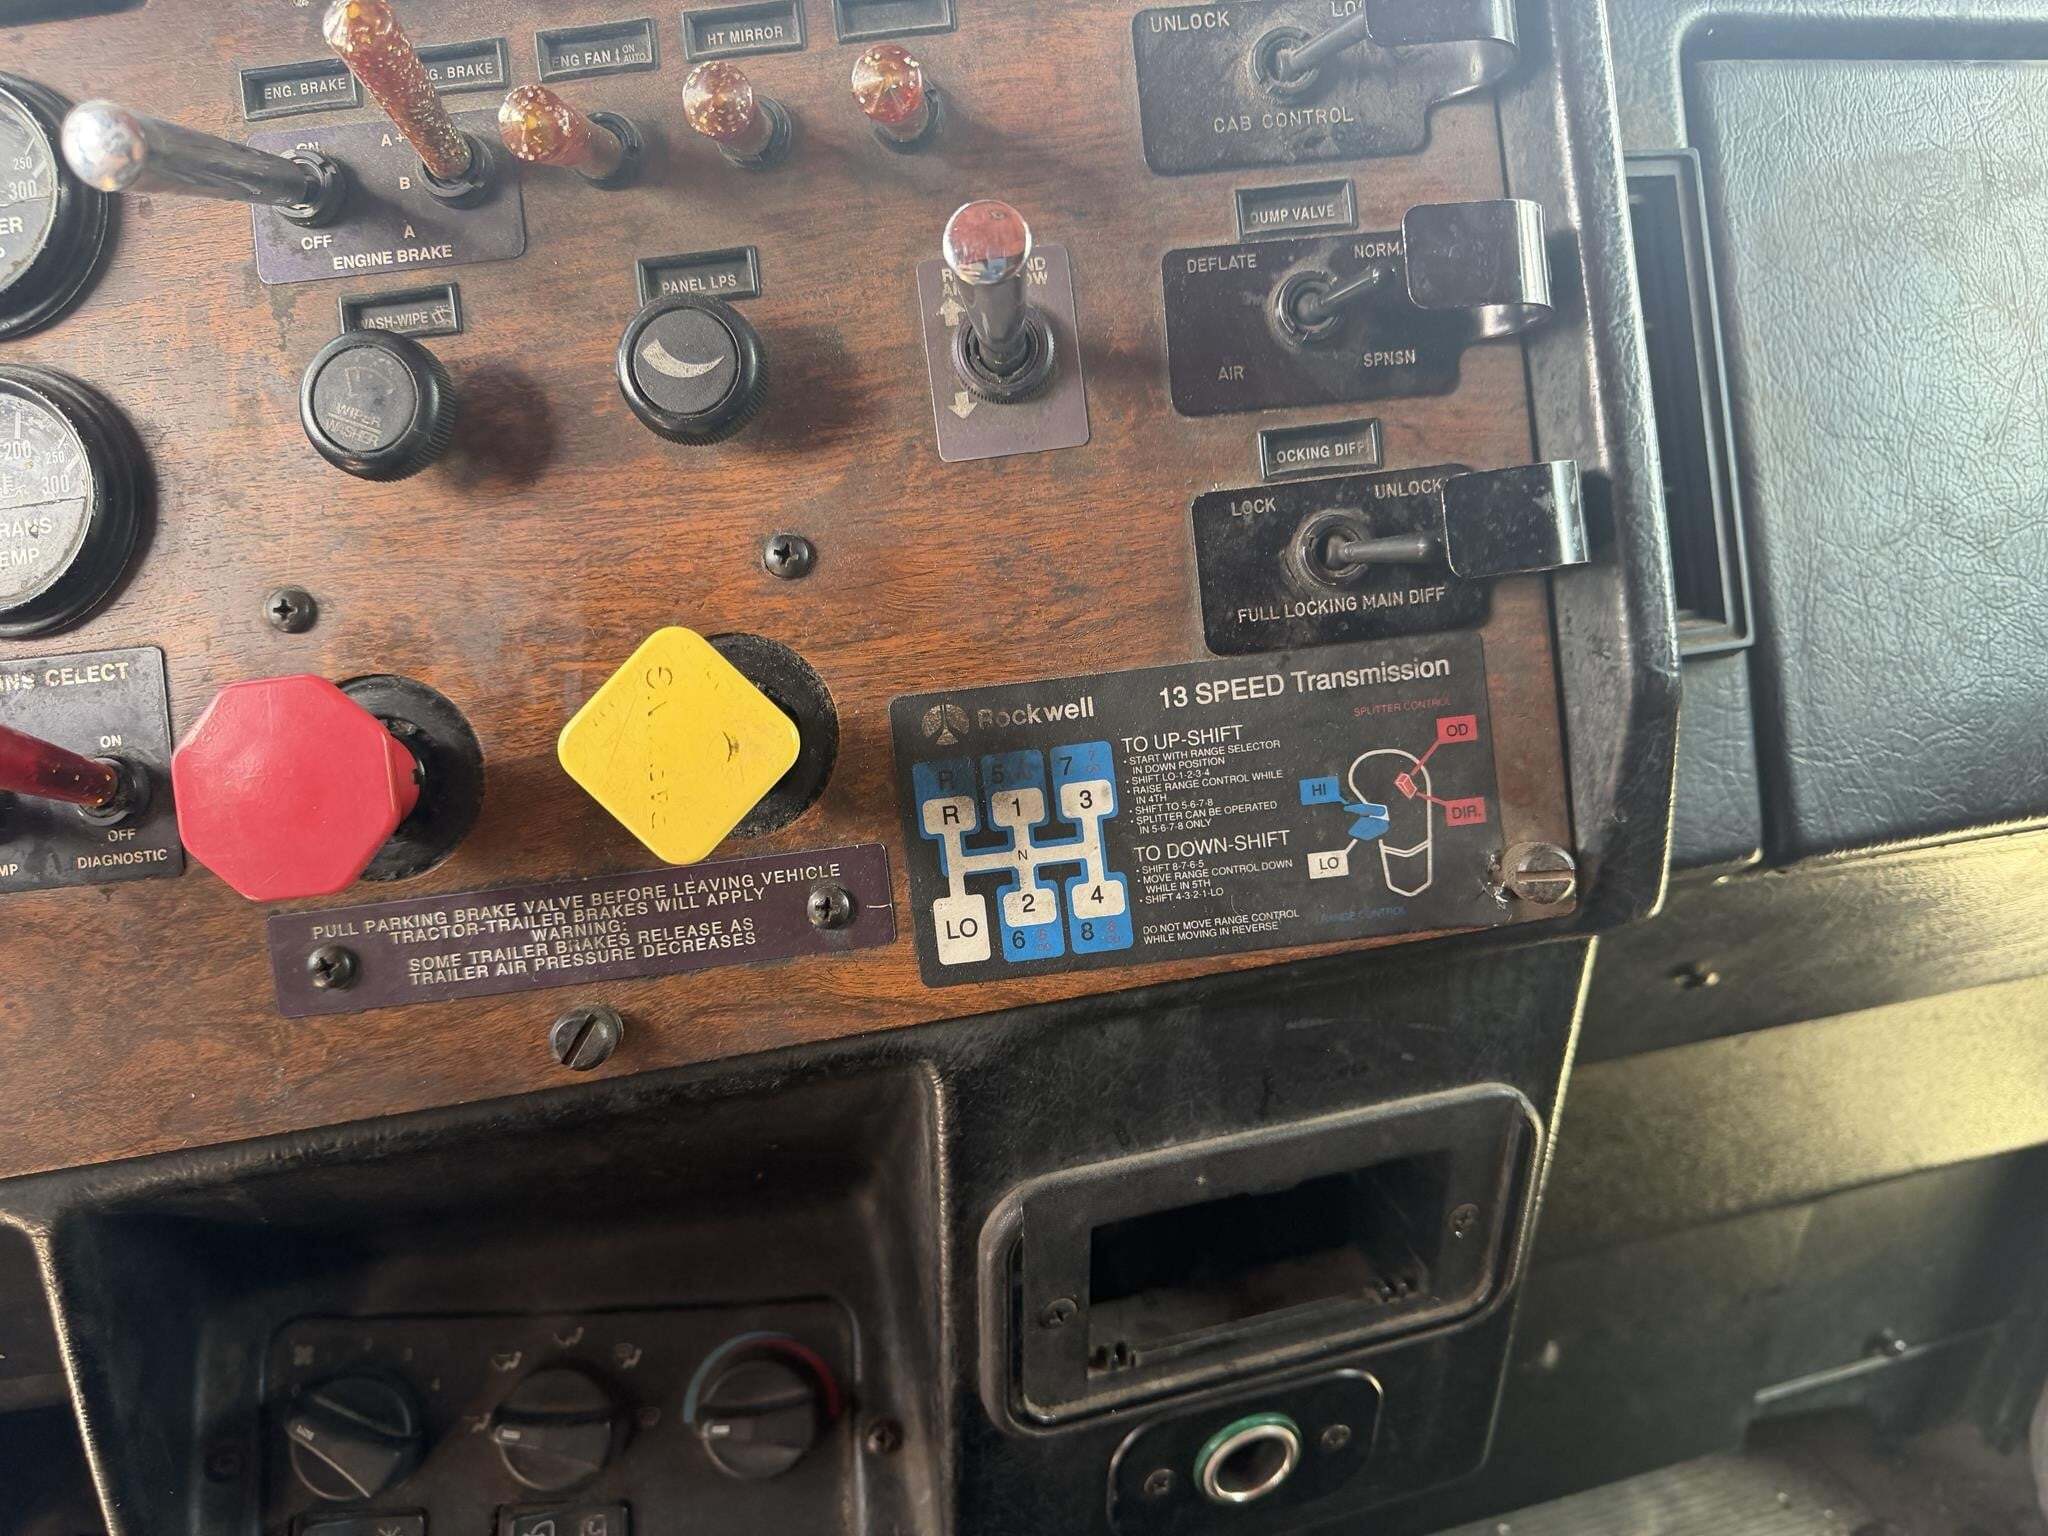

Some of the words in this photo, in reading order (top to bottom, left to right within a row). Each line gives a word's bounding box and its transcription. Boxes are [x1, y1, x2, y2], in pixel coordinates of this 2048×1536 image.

[1150, 11, 1231, 33] UNLOCK
[706, 31, 726, 47] HT
[729, 26, 784, 44] MIRROR
[551, 53, 580, 67] ENG
[584, 49, 611, 65] FAN
[621, 43, 635, 54] ON
[623, 52, 646, 64] AUTO
[446, 62, 494, 80] BRAKE
[264, 85, 297, 101] ENG.
[300, 77, 347, 95] BRAKE
[1213, 115, 1252, 134] CAB
[1262, 107, 1355, 130] CONTROL
[381, 134, 393, 147] A
[13, 156, 33, 170] 250
[8, 180, 38, 199] 300
[400, 175, 411, 190] B
[1291, 204, 1336, 221] VALVE
[404, 224, 415, 239] A
[301, 234, 333, 251] OFF
[1354, 242, 1405, 259] NORM
[332, 249, 394, 270] ENGINE
[396, 244, 453, 264] BRAKE
[1186, 254, 1257, 275] DEFLATE
[661, 277, 706, 295] PANEL
[709, 272, 737, 290] LPS
[1217, 366, 1245, 381] AIR
[1363, 350, 1416, 367] SPNSN
[4, 440, 32, 460] 200
[46, 451, 65, 465] 250
[1274, 446, 1330, 465] OCKING
[41, 474, 71, 495] 300
[1374, 478, 1442, 499] UNLOCK
[1231, 498, 1277, 517] LOCK
[1237, 604, 1280, 624] FULL
[1284, 597, 1357, 619] LOCKING
[1362, 591, 1405, 610] MAIN
[1409, 586, 1446, 605] DIFF
[45, 662, 129, 687] CELECT
[1159, 686, 1188, 709] 13
[1195, 674, 1284, 705] SPEED
[1291, 658, 1450, 694] Transmission
[976, 696, 1095, 729] Rockwell
[1121, 735, 1149, 754] TO
[1154, 724, 1243, 750] UP-SHIFT
[1446, 722, 1469, 738] OD
[100, 734, 122, 749] ON
[1129, 754, 1160, 766] START
[1163, 751, 1188, 763] WITH
[1190, 747, 1226, 760] RANGE
[1227, 740, 1281, 755] SELECTOR
[1059, 756, 1073, 776] 7
[1132, 766, 1143, 775] IN
[1145, 762, 1177, 774] DOWN
[1178, 756, 1226, 771] POSITION
[1131, 774, 1159, 786] SHIFT
[1162, 769, 1210, 782] LO-1-2-3-4
[1132, 783, 1162, 796] RAISE
[1164, 779, 1199, 792] RANGE
[1201, 774, 1250, 788] CONTROL
[1251, 769, 1283, 781] WHILE
[1079, 789, 1093, 810] 3
[1136, 796, 1146, 805] IN
[1148, 793, 1167, 803] 4TH
[1311, 783, 1327, 797] HI
[942, 804, 960, 825] R
[1011, 797, 1021, 817] 1
[1135, 803, 1163, 816] SHIFT
[1165, 802, 1180, 812] TO
[1181, 798, 1214, 810] 5-6-7-8
[1136, 812, 1184, 826] SPLITTER
[1185, 809, 1206, 820] CAN
[1208, 806, 1223, 817] BE
[1224, 800, 1278, 815] OPERATED
[1452, 804, 1482, 820] DIR.
[108, 828, 136, 842] OFF
[1139, 825, 1149, 834] IN
[1151, 820, 1184, 833] 5-6-7-8
[1185, 818, 1212, 829] ONLY
[1017, 848, 1028, 861] N
[1133, 846, 1161, 863] TO
[1166, 829, 1291, 860] DOWN-SHIFT
[77, 849, 168, 870] DIAGNOSTIC
[1141, 863, 1170, 875] SHIFT
[1172, 860, 1205, 872] 8-7-6-5
[1319, 856, 1339, 872] LO
[1142, 873, 1173, 885] MOVE
[1174, 869, 1209, 881] RANGE
[1211, 863, 1260, 877] CONTROL
[1261, 859, 1294, 871] DOWN
[1090, 884, 1105, 904] 4
[1145, 882, 1177, 895] WHILE
[1180, 881, 1190, 890] IN
[1191, 879, 1211, 889] 5TH
[1145, 893, 1173, 905] SHIFT
[1175, 886, 1224, 901] 4-3-2-1-LO
[312, 922, 359, 940] PULL
[363, 911, 448, 934] PARKING
[452, 903, 516, 923] BRAKE
[523, 895, 584, 915] VALVE
[591, 886, 667, 907] BEFORE
[673, 874, 754, 897] LEAVING
[760, 863, 841, 885] VEHICLE
[1022, 893, 1036, 914] 2
[389, 913, 565, 946] TRACTOR-TRAILER
[572, 904, 648, 925] BRAKES
[655, 896, 700, 914] WILL
[707, 887, 765, 908] APPLY
[1142, 925, 1158, 935] DO
[1159, 921, 1181, 933] NOT
[1182, 917, 1213, 930] MOVE
[1214, 913, 1249, 926] RANGE
[1251, 908, 1300, 923] CONTROL
[530, 919, 627, 943] WARNING:
[945, 918, 978, 941] LO
[1080, 921, 1095, 941] 8
[1143, 933, 1175, 945] WHILE
[1176, 928, 1218, 942] MOVING
[1219, 925, 1230, 936] IN
[1231, 921, 1279, 935] REVERSE
[408, 953, 462, 972] SOME
[466, 942, 549, 965] TRAILER
[555, 932, 630, 954] BRAKES
[637, 921, 722, 943] RELEASE
[729, 917, 754, 932] AS
[1011, 930, 1026, 950] 6
[408, 964, 489, 986] TRAILER
[496, 959, 527, 976] AIR
[534, 948, 637, 972] PRESSURE
[642, 931, 757, 959] DECREASES
